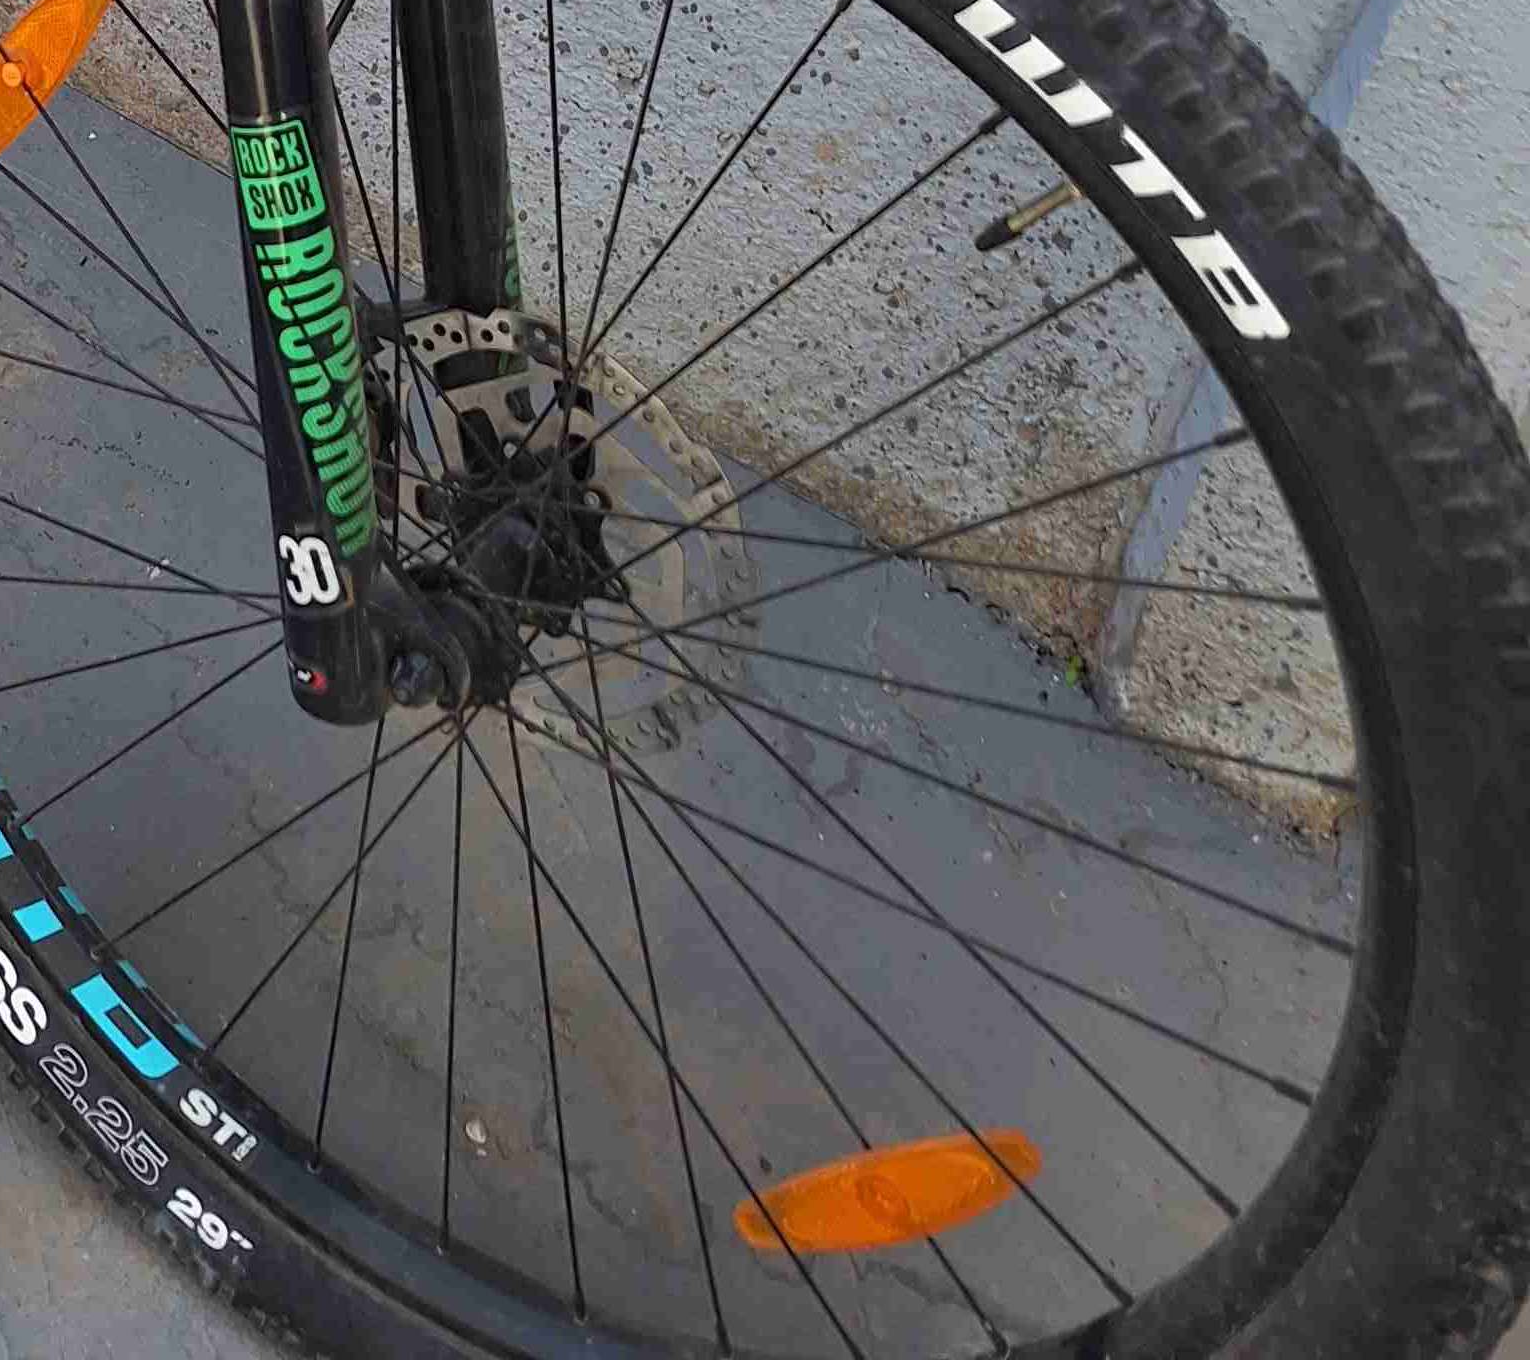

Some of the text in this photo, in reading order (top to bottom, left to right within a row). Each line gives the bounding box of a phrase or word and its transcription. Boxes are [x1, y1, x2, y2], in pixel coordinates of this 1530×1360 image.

[236, 131, 304, 175] ROCK
[248, 175, 316, 220] SHOX
[278, 534, 340, 606] 30
[38, 1043, 170, 1186] 2.25
